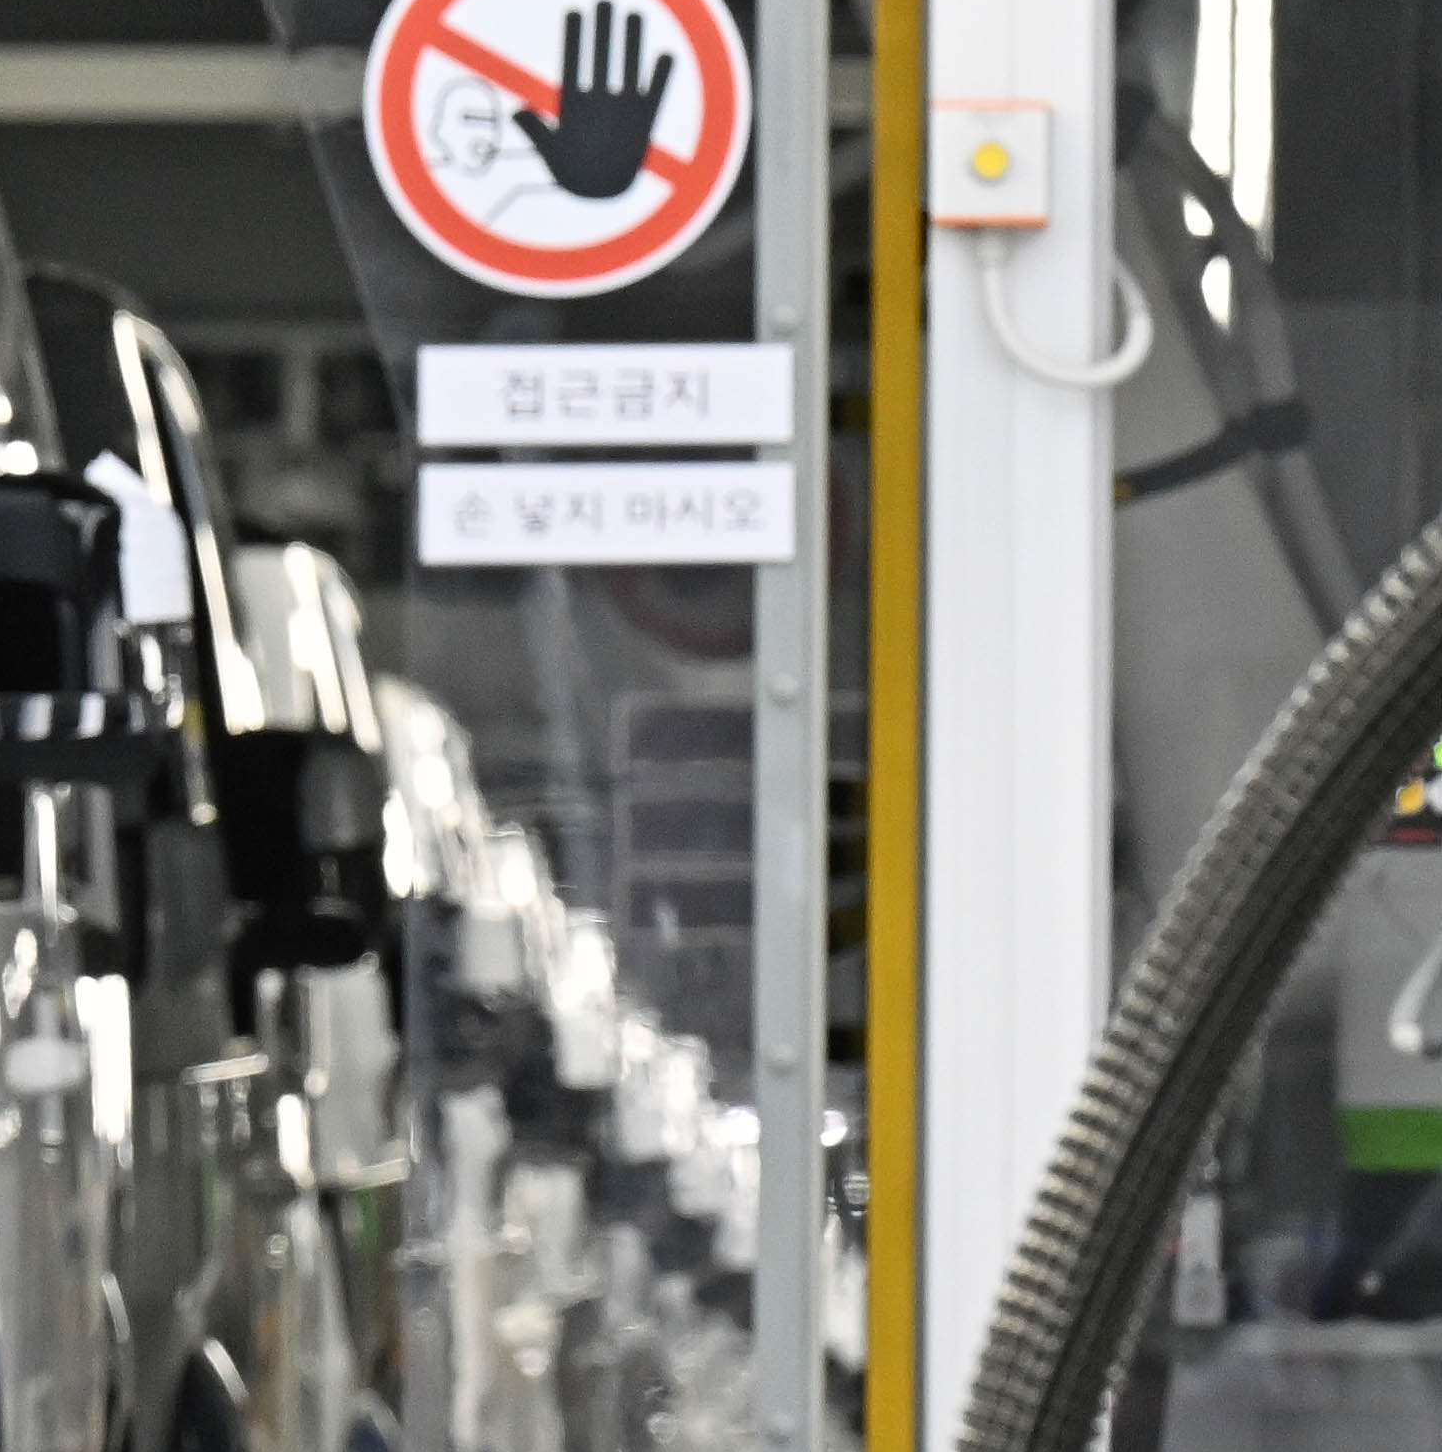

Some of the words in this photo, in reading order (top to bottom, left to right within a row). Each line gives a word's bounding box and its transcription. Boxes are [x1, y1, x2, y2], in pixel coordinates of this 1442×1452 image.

[503, 368, 710, 421] 접근금지
[453, 489, 492, 538] 손
[624, 485, 764, 533] 마시오
